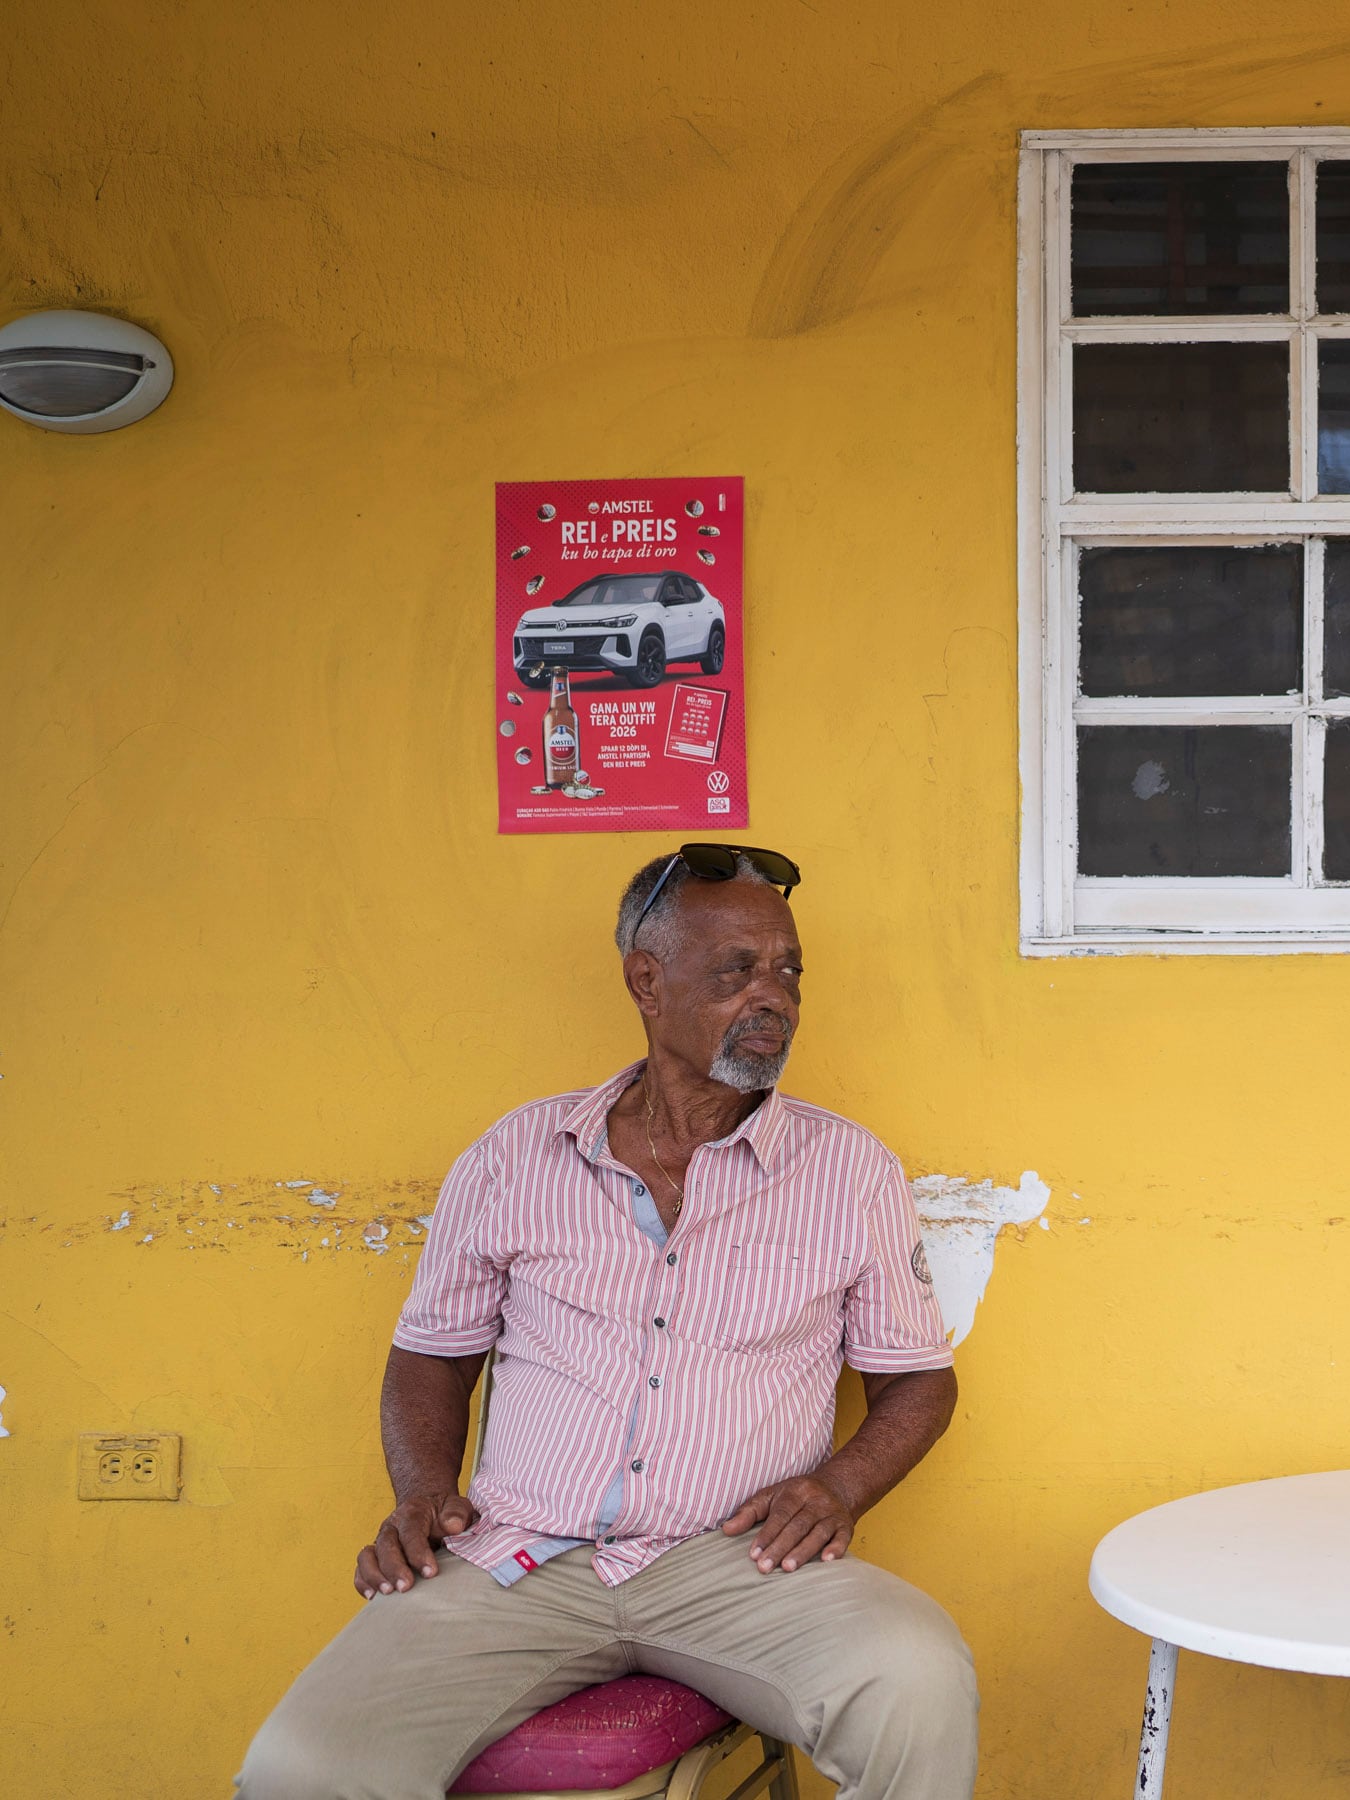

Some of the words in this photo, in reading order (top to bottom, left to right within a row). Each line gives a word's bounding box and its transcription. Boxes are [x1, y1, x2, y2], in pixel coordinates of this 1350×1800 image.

[601, 500, 654, 514] AMSTEL
[561, 520, 597, 544] REI
[600, 533, 609, 543] e
[612, 518, 678, 543] PREIS
[561, 546, 579, 560] ku
[583, 545, 599, 559] bo
[601, 546, 633, 563] tapa
[636, 543, 653, 557] di
[654, 547, 677, 557] oro
[590, 702, 619, 714] GANA
[622, 702, 637, 713] UN
[639, 701, 656, 713] VW
[589, 714, 617, 726] TERA
[619, 713, 657, 725] OUTFIT
[610, 726, 637, 738] 2026
